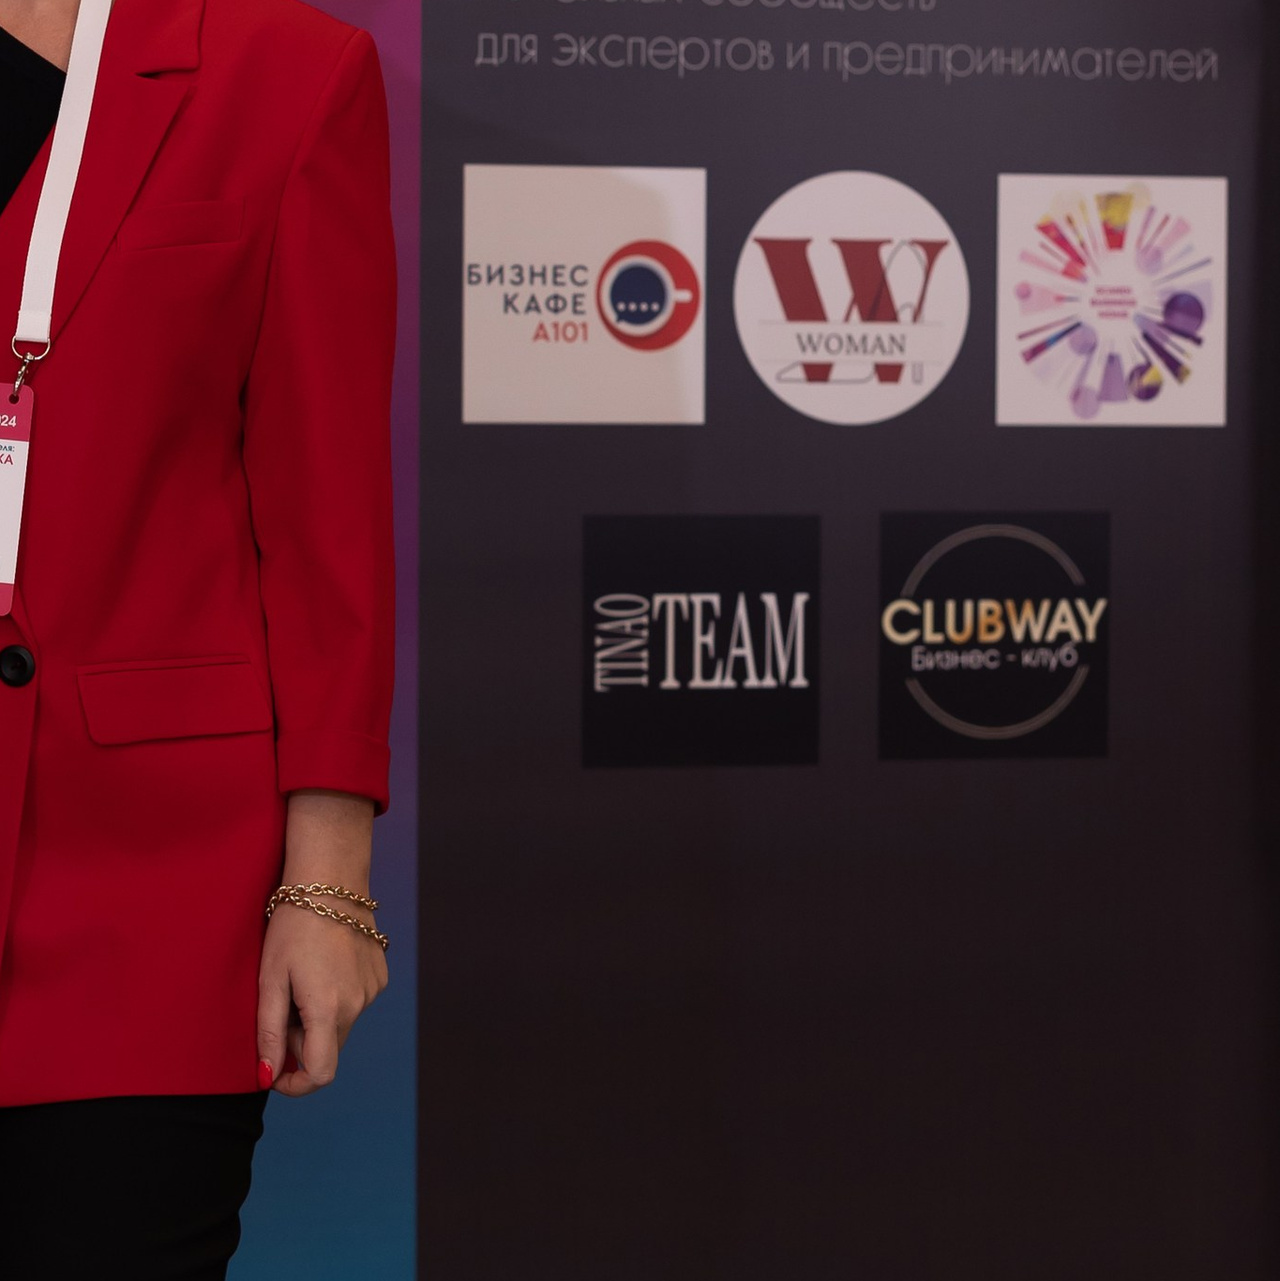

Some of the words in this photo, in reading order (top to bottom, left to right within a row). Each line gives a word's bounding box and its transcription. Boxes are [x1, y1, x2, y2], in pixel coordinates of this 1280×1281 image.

[475, 33, 539, 68] для
[552, 33, 775, 79] экспертов
[786, 41, 810, 72] и
[823, 40, 1219, 85] предпринимателей
[467, 263, 589, 288] БИЗНЕС
[503, 292, 586, 316] КАФЕ
[796, 333, 907, 355] WOMAN
[652, 592, 810, 689] TEAM
[881, 598, 1107, 645] CLUBWAY
[594, 592, 650, 692] TINAO
[911, 645, 1001, 671] Бизнес
[1021, 641, 1079, 672] клуб
